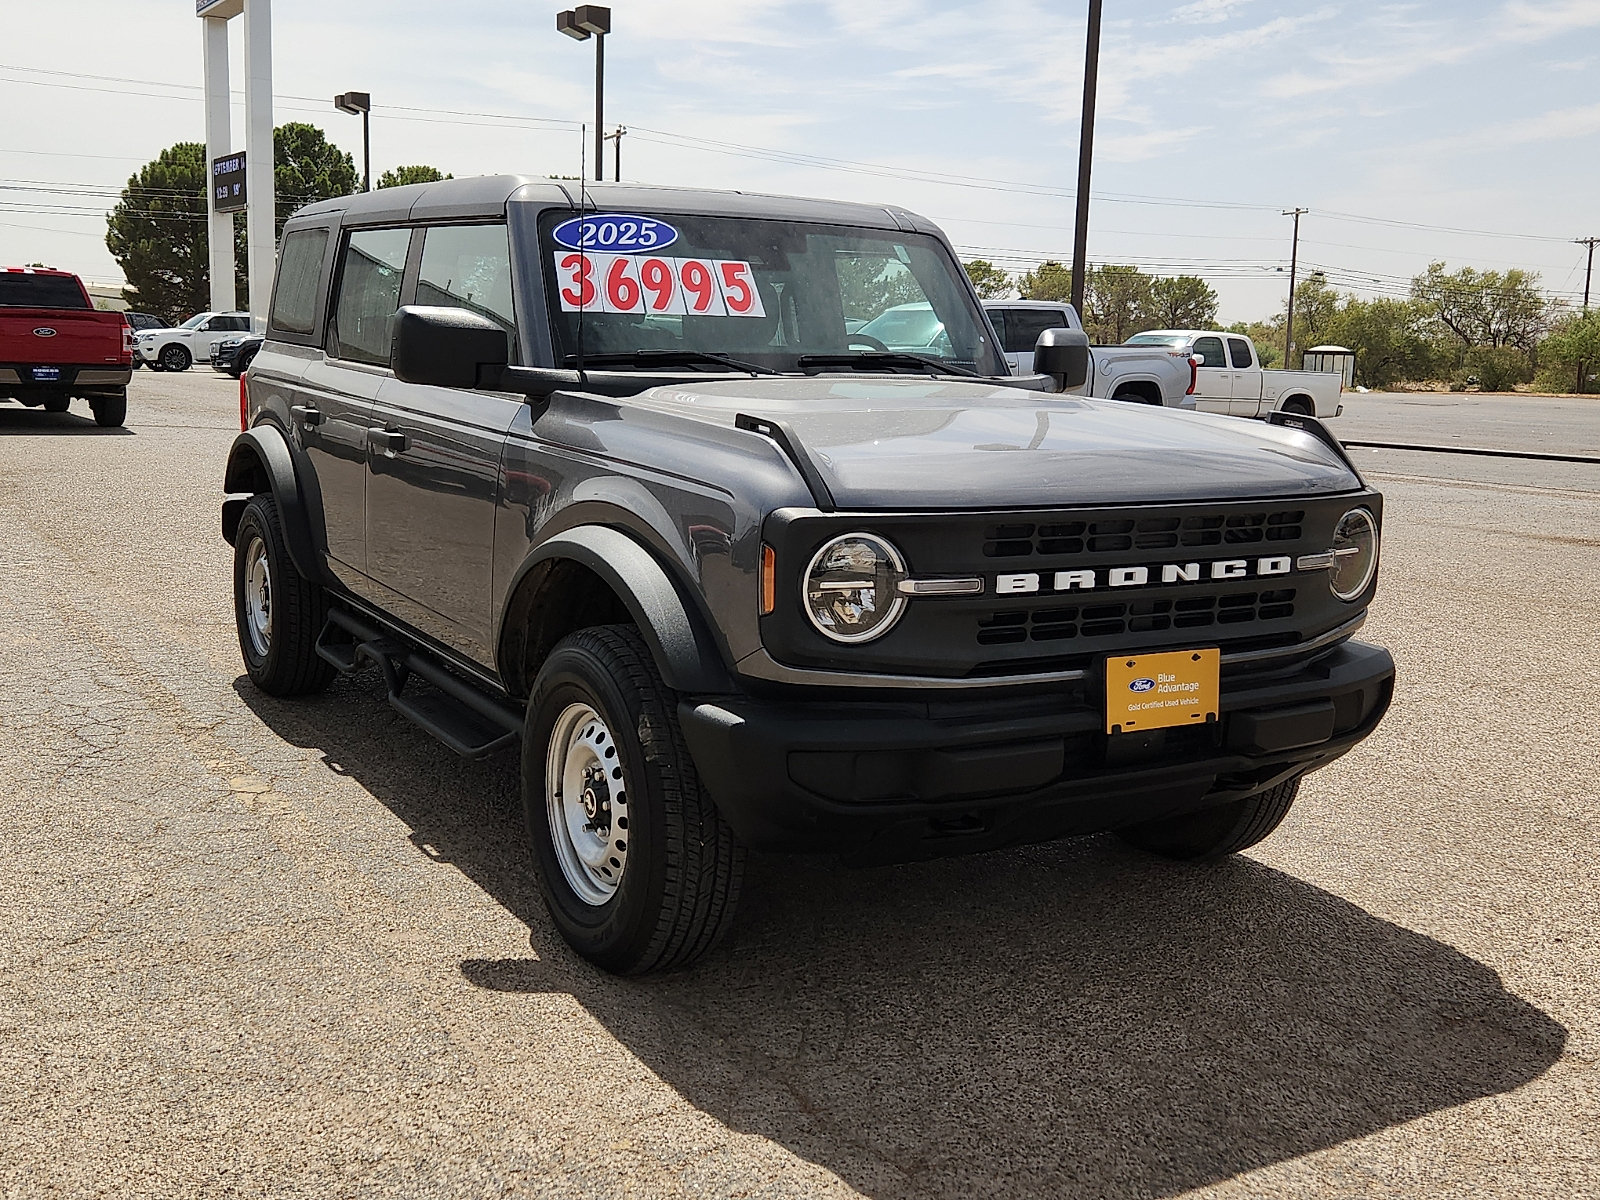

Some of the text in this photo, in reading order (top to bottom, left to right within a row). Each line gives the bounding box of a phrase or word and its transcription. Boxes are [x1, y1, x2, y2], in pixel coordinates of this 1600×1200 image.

[577, 222, 658, 247] 2025
[560, 254, 754, 313] 36995
[995, 556, 1292, 594] BRONCO
[1157, 673, 1176, 683] Blue
[1157, 682, 1199, 693] Advantage
[1127, 697, 1199, 711] Gold Certified Used Vehicle
